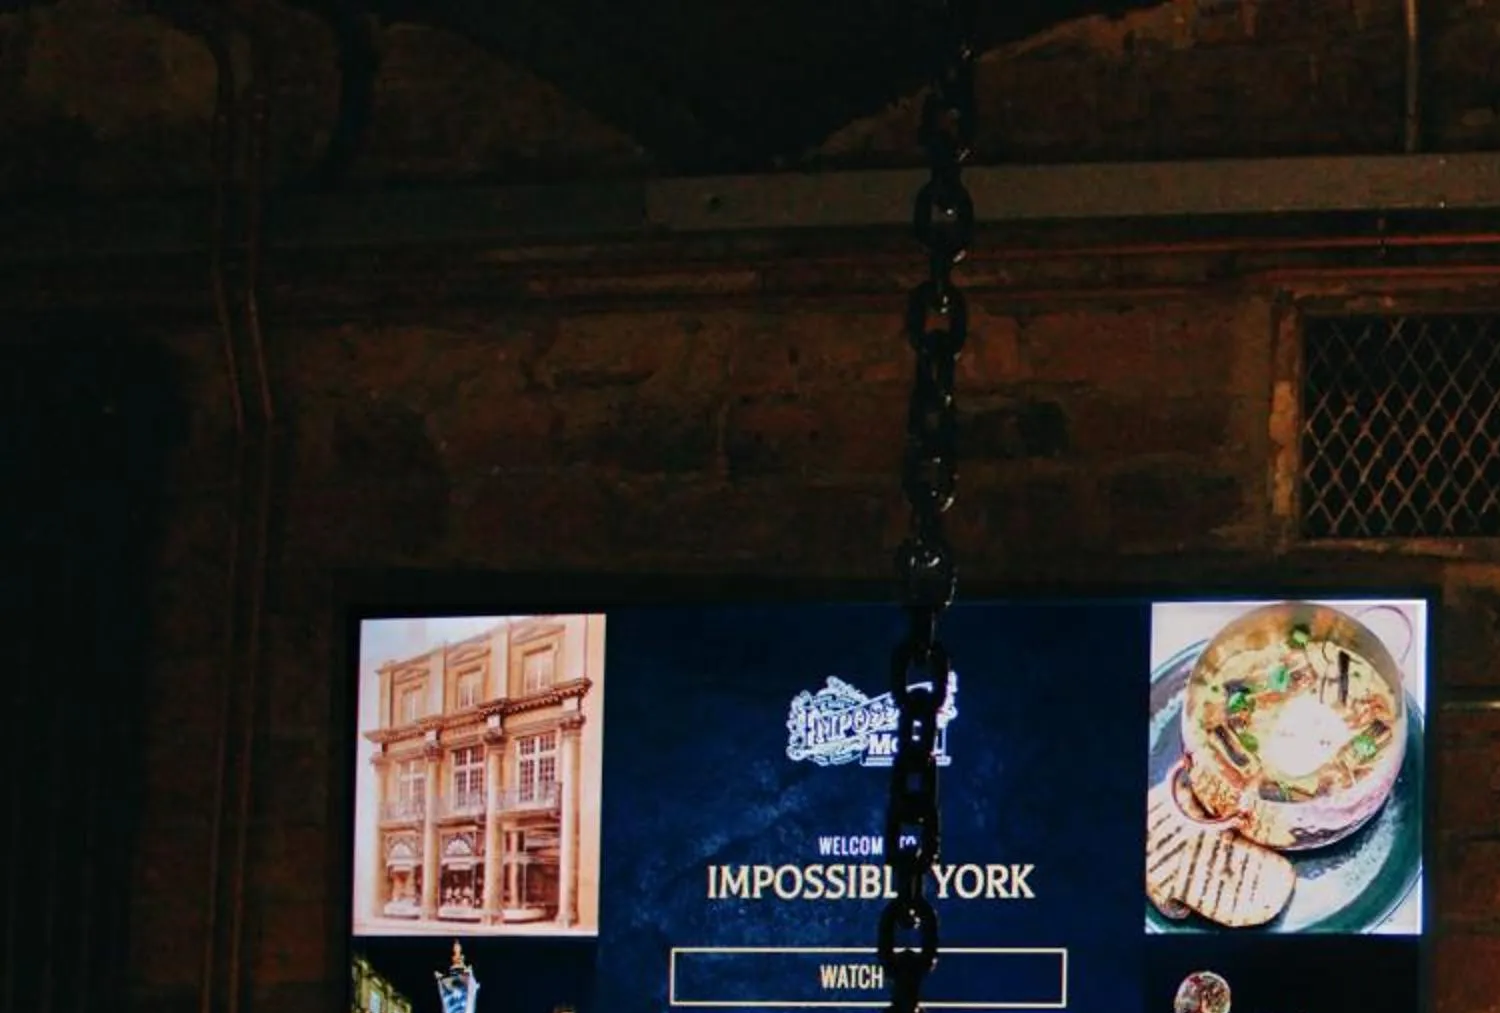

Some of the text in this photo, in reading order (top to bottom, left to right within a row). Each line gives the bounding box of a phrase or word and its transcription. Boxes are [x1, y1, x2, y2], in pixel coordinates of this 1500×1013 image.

[819, 835, 884, 857] WELCOM
[707, 863, 1036, 899] IMPOSSIBL YORK
[820, 965, 884, 989] WATCH
